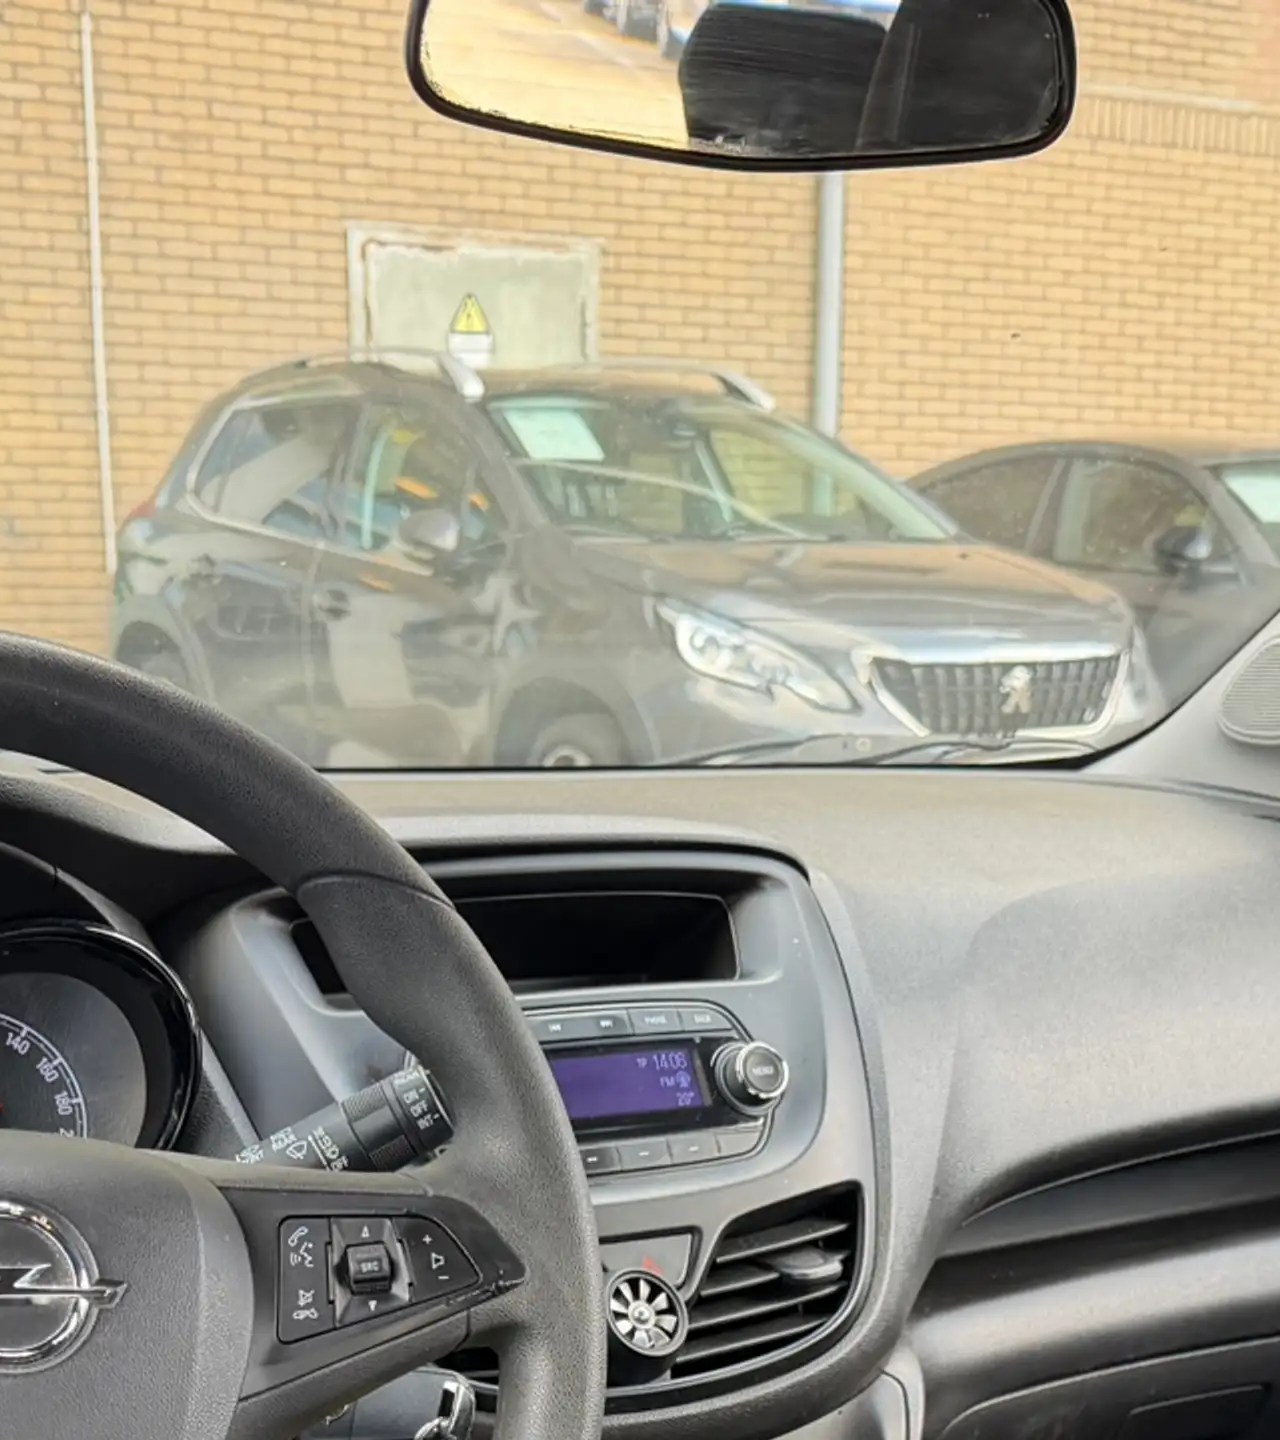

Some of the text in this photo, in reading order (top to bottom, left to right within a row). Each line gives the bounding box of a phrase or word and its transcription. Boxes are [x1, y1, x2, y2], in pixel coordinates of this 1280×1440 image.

[5, 1032, 31, 1055] 140
[35, 1057, 60, 1083] 160
[53, 1090, 73, 1116] 180
